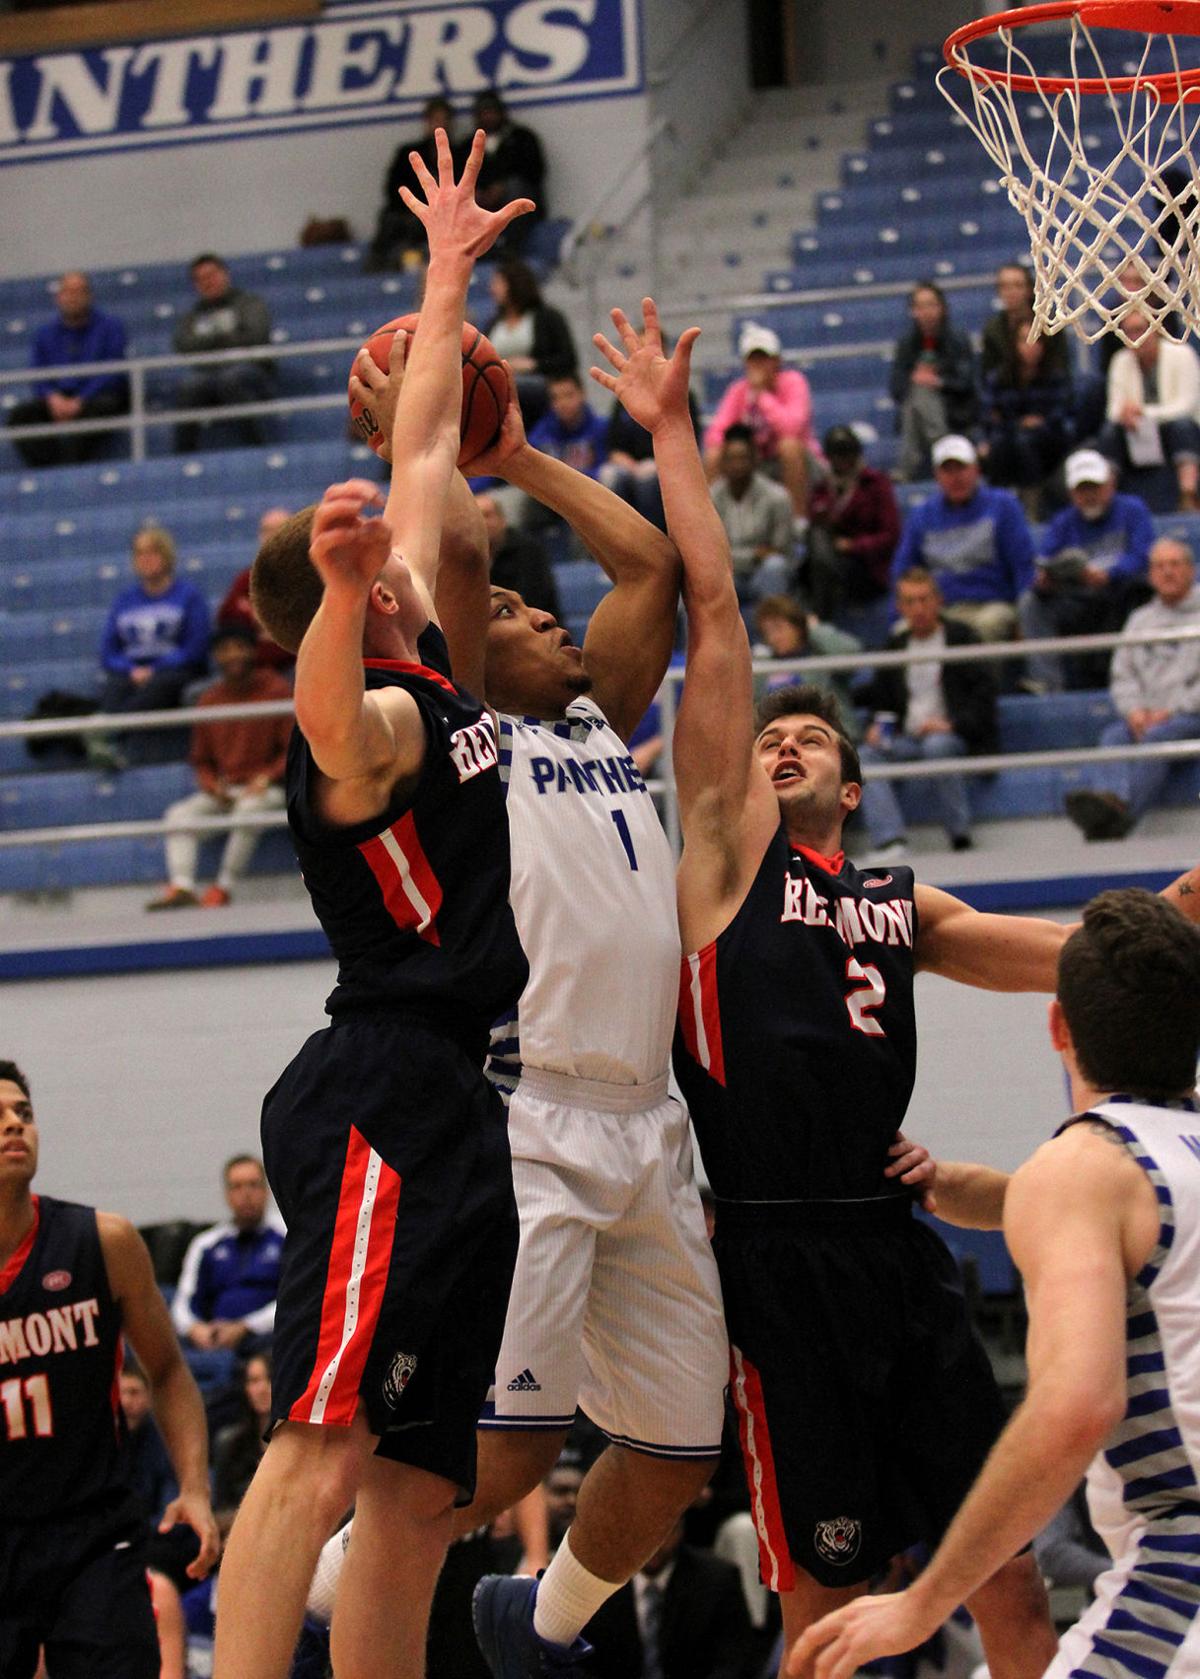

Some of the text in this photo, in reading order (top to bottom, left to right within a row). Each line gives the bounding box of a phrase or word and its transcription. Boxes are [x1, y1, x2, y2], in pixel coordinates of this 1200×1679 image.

[611, 809, 639, 872] 1
[845, 955, 887, 1037] 2
[0, 1373, 54, 1440] 11
